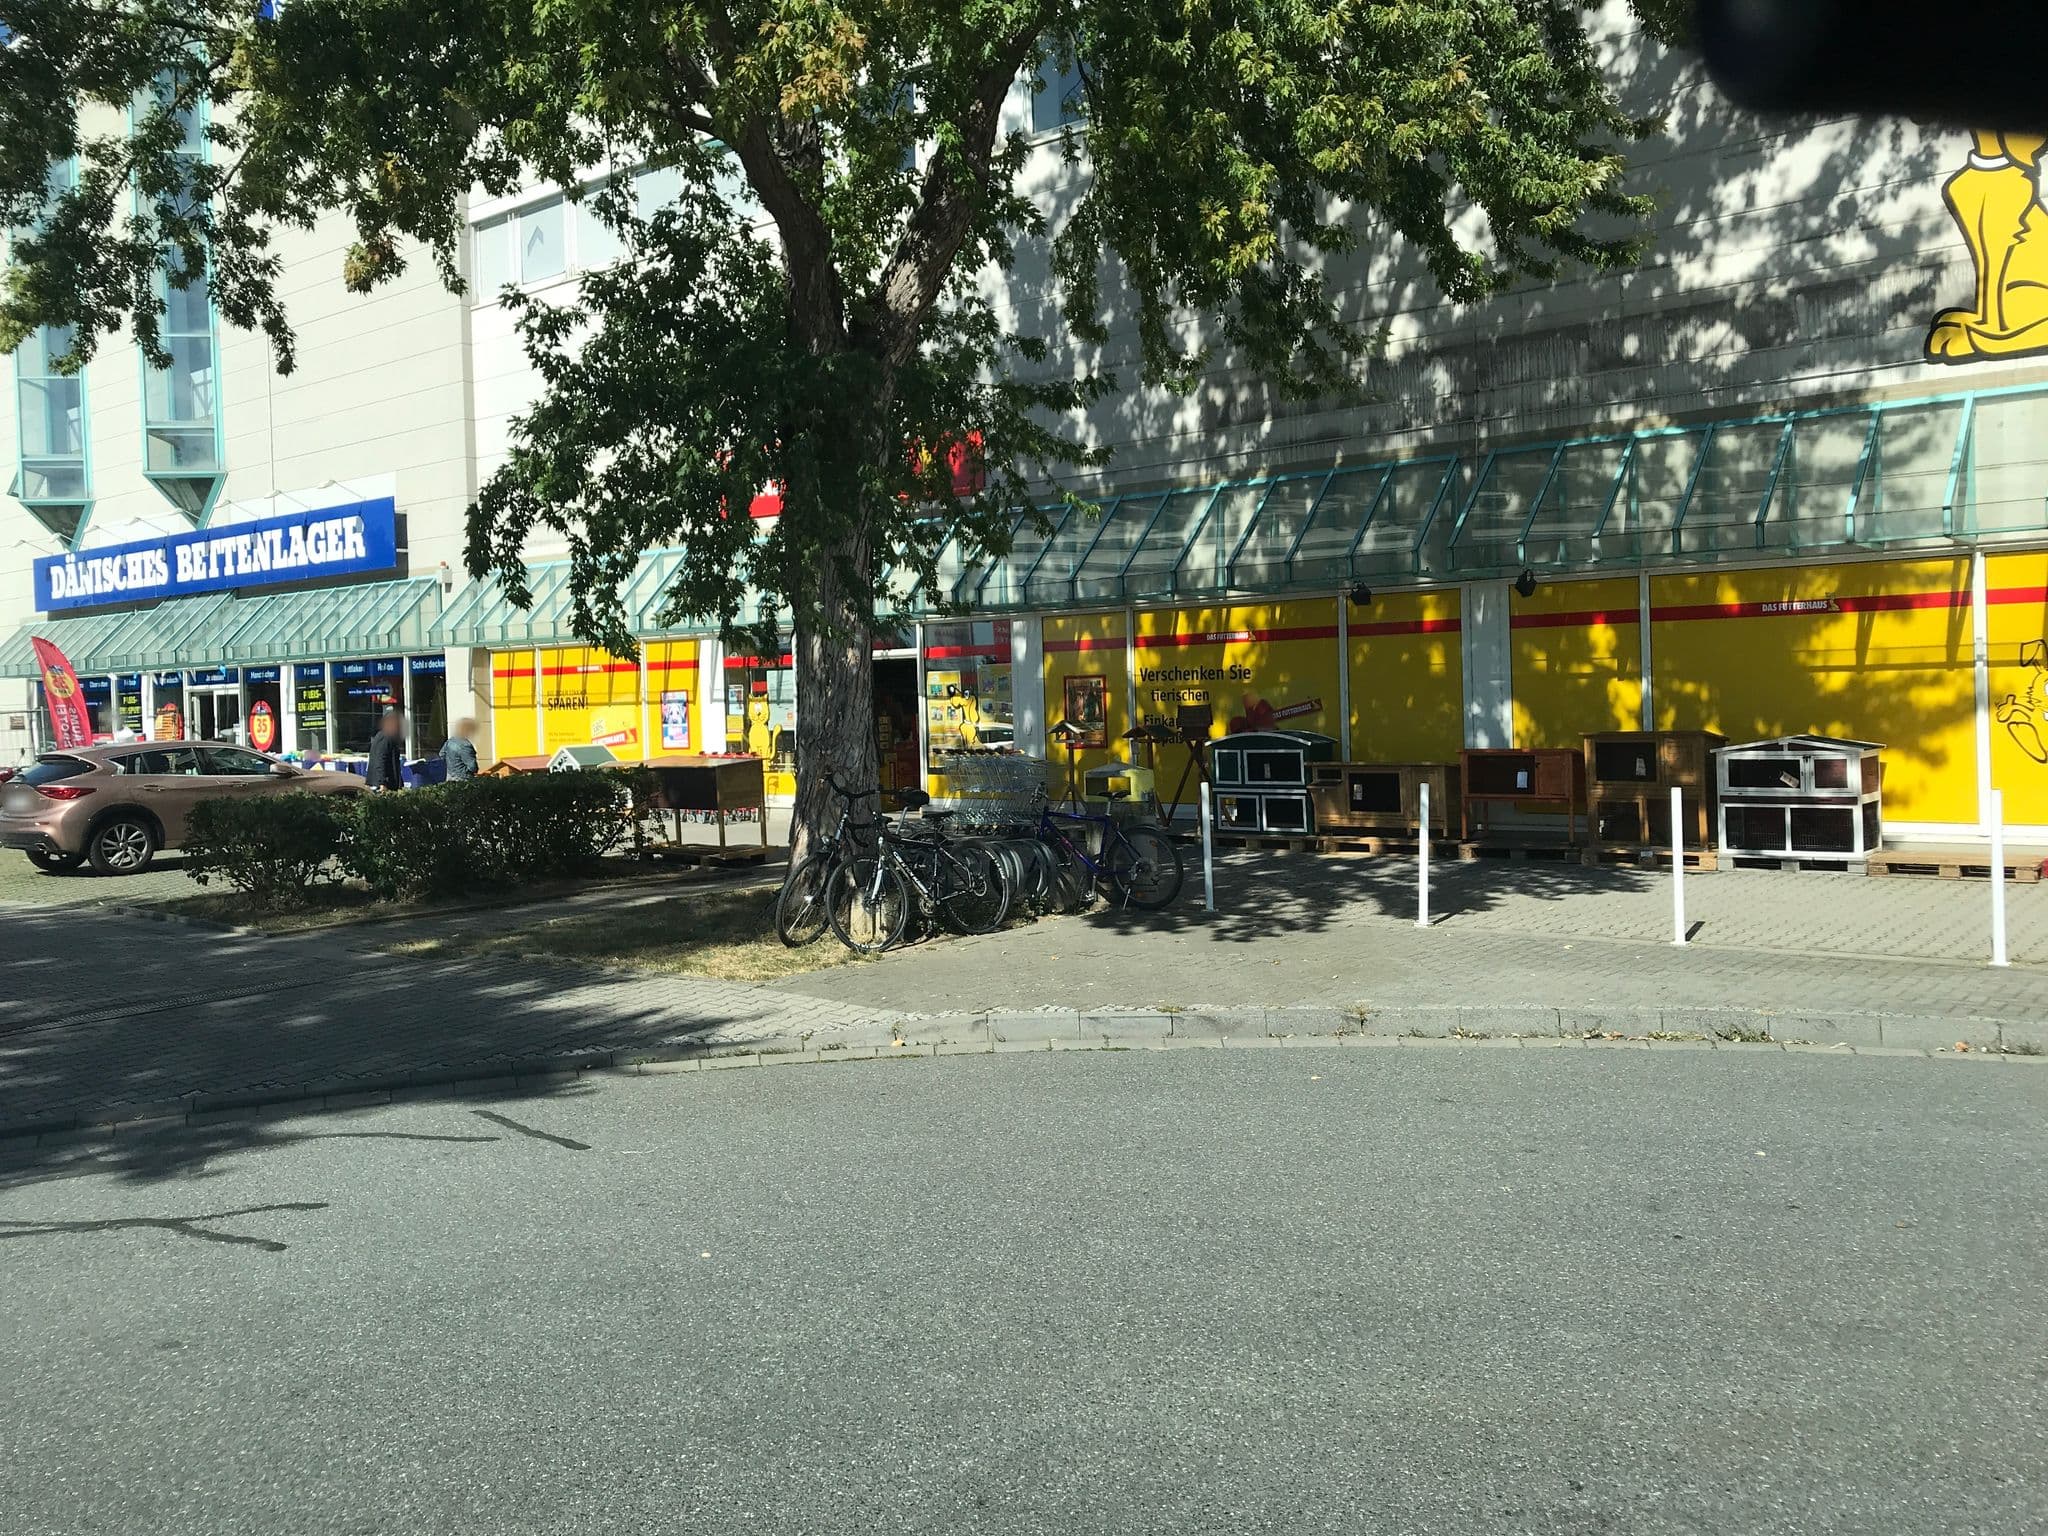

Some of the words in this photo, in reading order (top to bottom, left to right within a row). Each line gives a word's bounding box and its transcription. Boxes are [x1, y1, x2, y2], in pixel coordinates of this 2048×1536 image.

[50, 549, 169, 600] DÄNISCHES
[175, 515, 366, 583] BETTENLAGER
[1762, 603, 1777, 611] DAS
[1778, 600, 1828, 611] FUTTERHAUS
[1206, 633, 1217, 641] DAS
[1139, 665, 1225, 682] Verschenken
[1230, 664, 1252, 680] Sie
[1151, 687, 1209, 702] tierischen
[547, 696, 589, 711] SPAREN!
